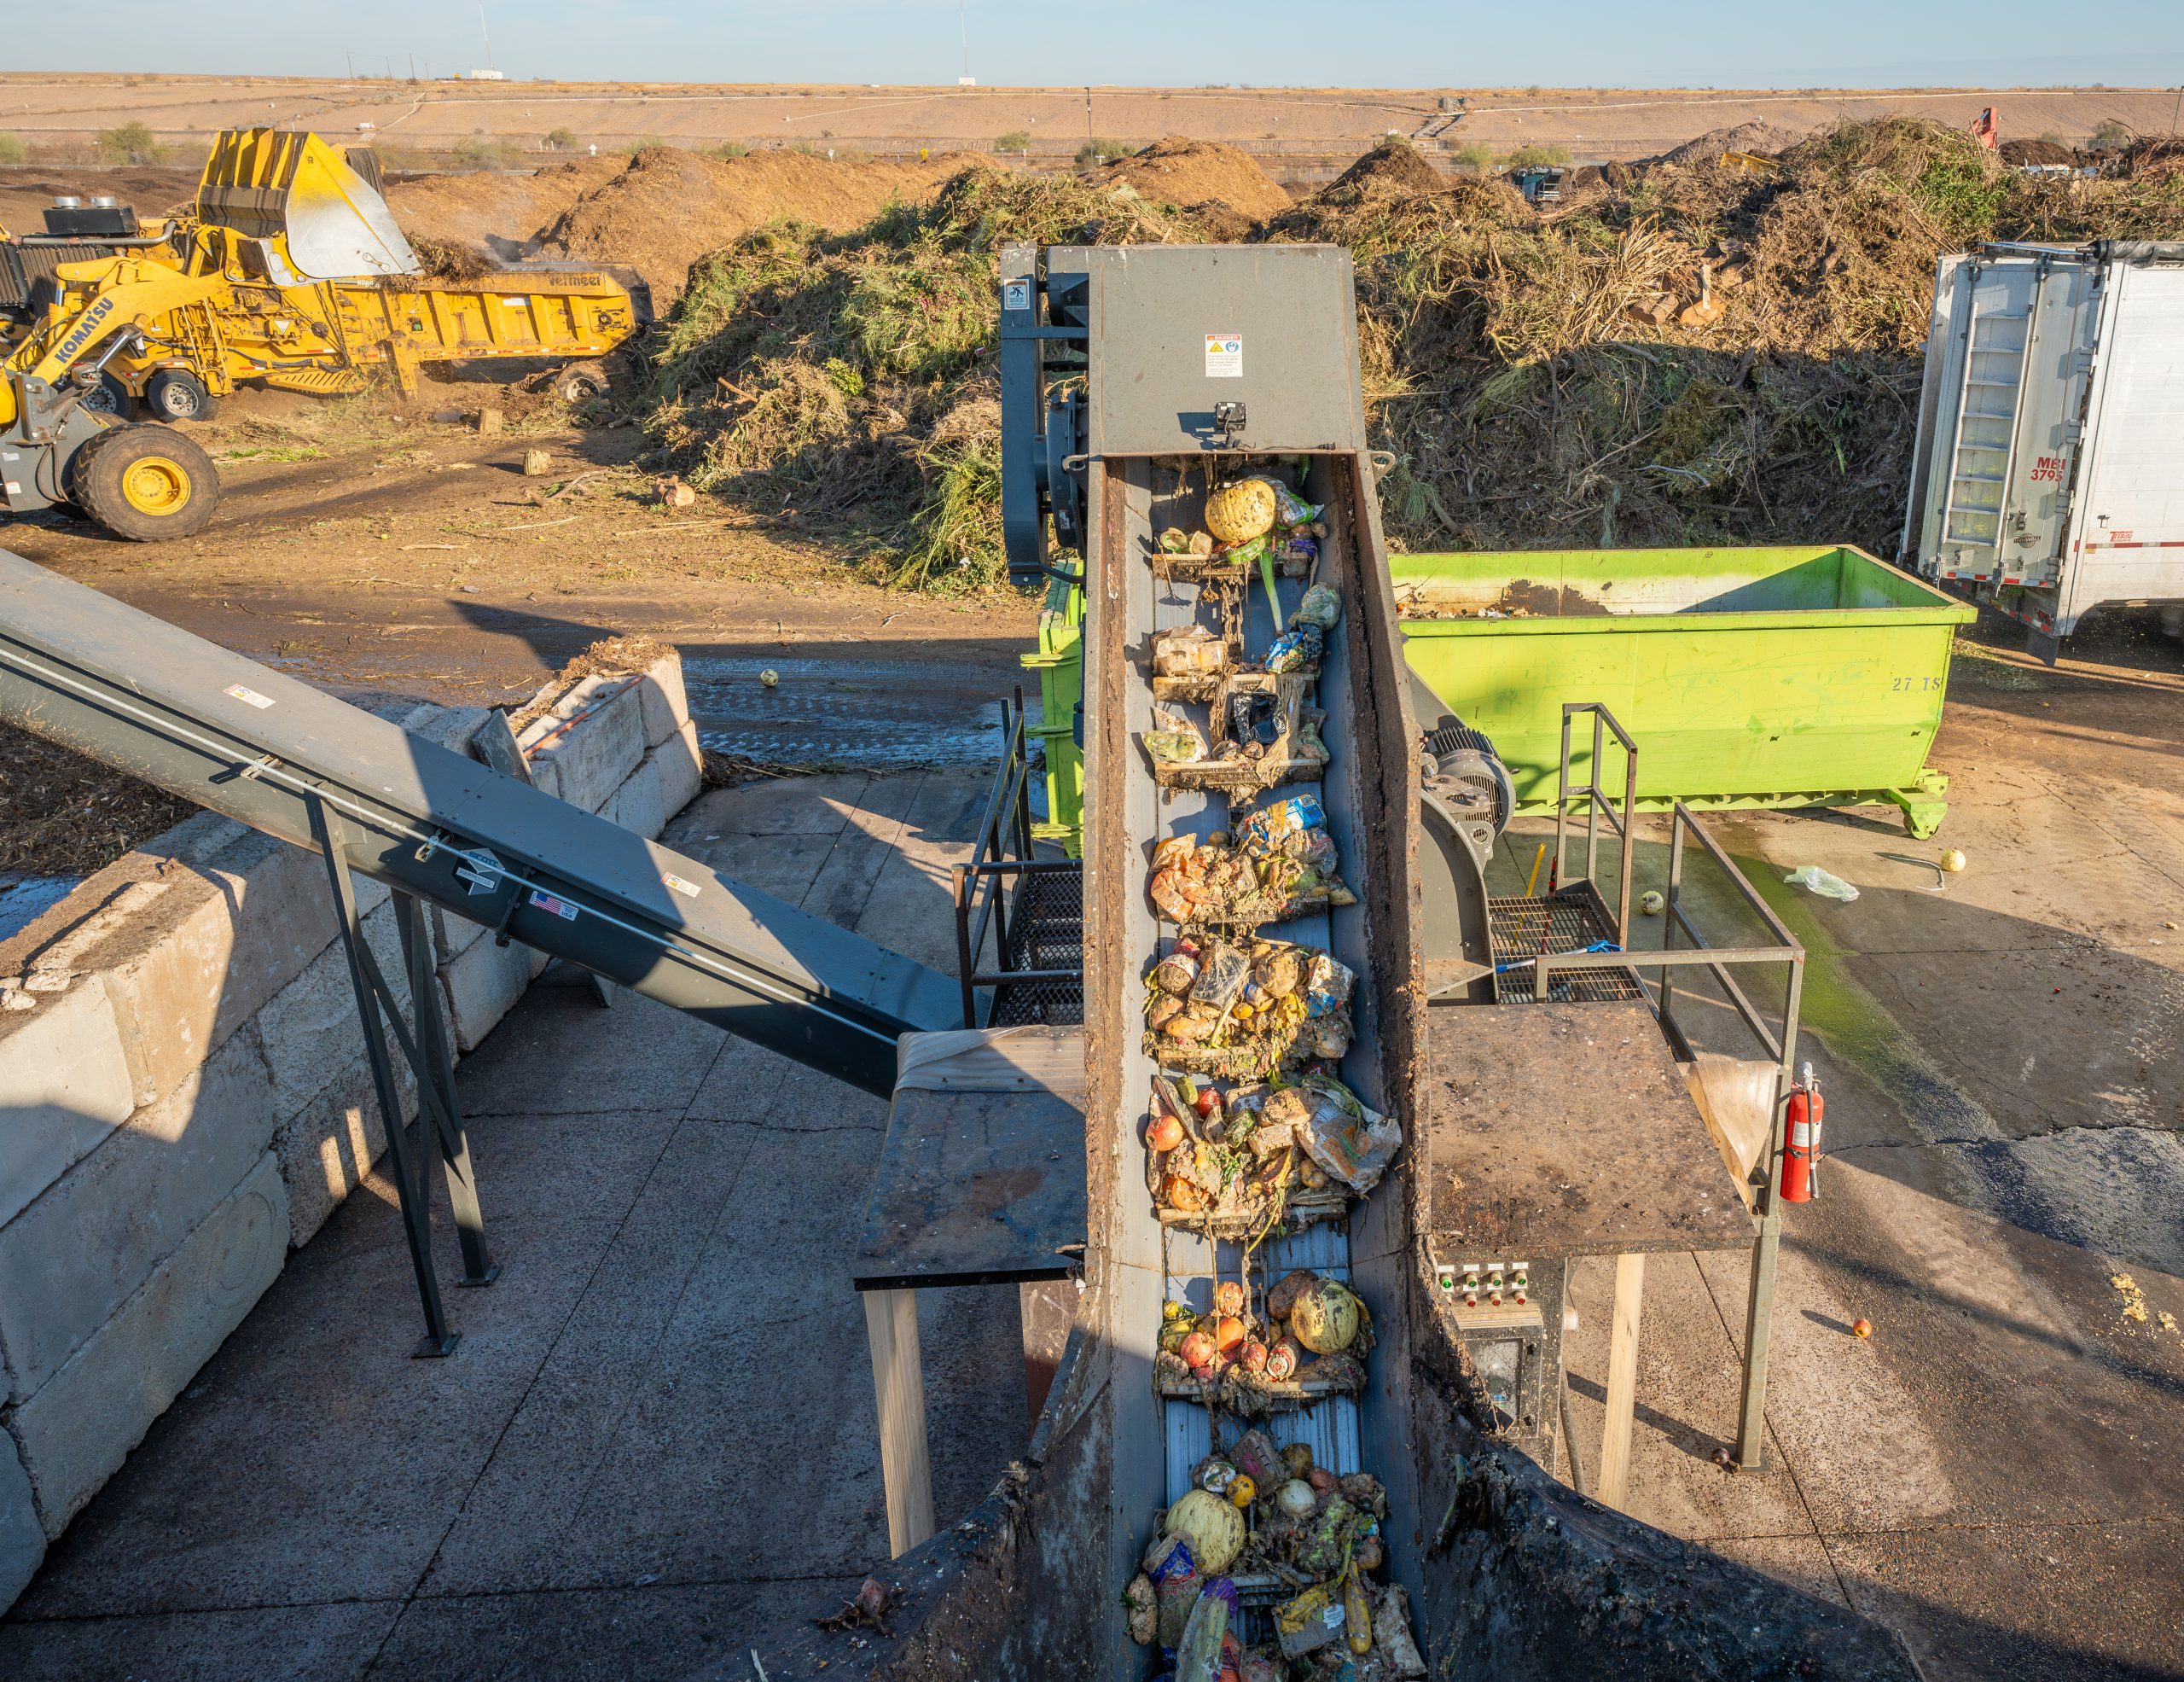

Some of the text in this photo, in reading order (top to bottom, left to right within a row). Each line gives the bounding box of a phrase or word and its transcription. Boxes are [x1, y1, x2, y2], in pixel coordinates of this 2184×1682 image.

[54, 296, 114, 364] KOMATSU
[2036, 457, 2066, 469] MBI
[1892, 677, 1941, 691] 27 TS
[468, 851, 499, 868] SCOTT
[561, 911, 572, 919] USA
